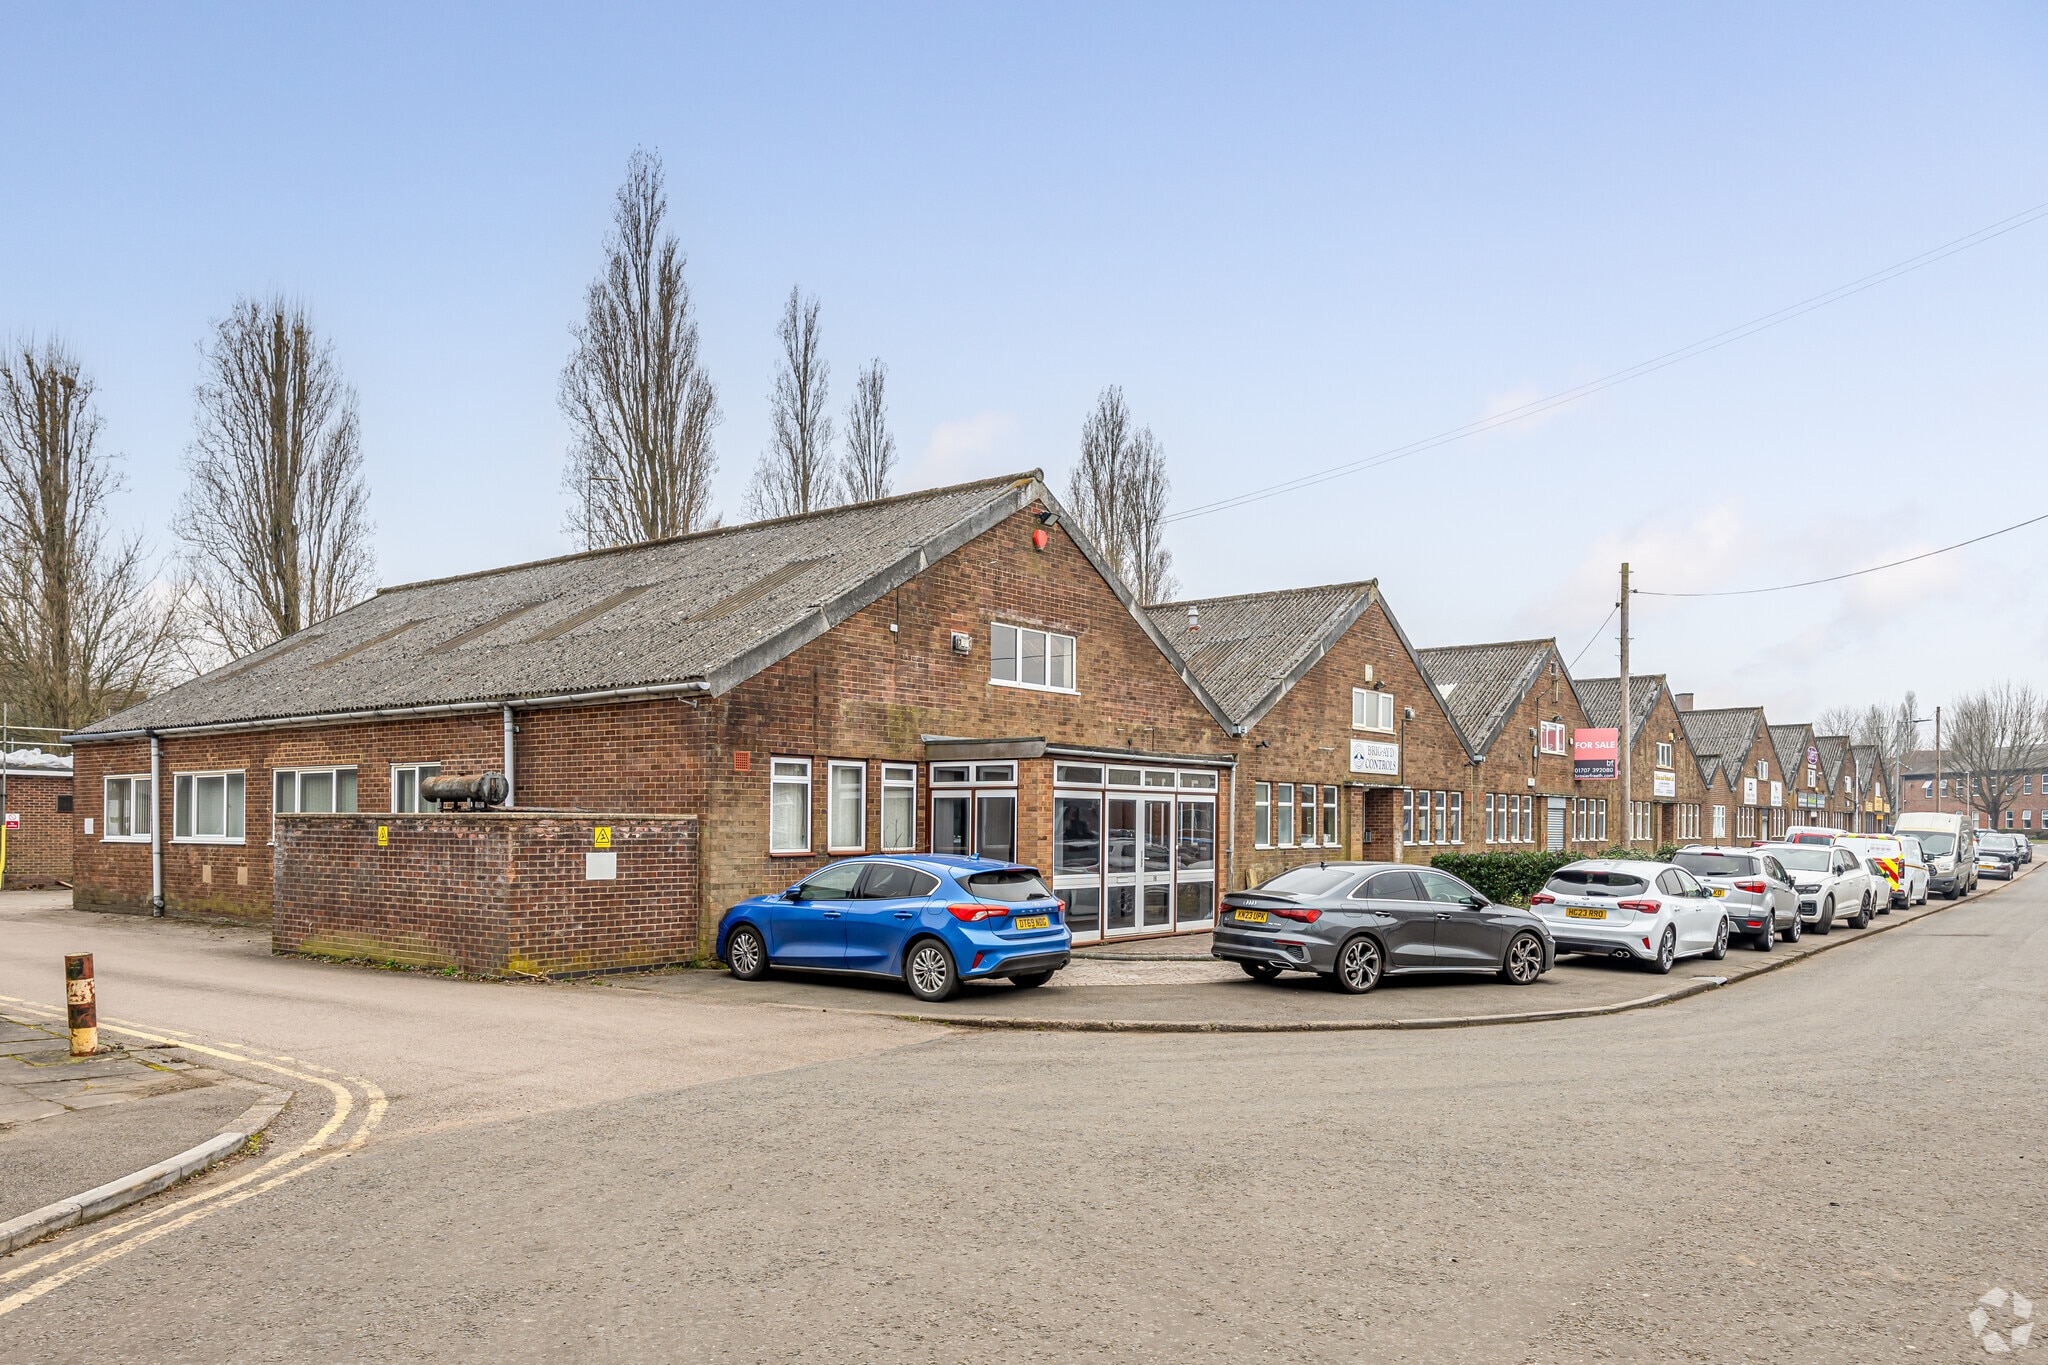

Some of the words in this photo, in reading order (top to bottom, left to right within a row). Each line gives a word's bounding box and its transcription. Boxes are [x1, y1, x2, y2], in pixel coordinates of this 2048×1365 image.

[1575, 741, 1592, 749] FOR
[1595, 741, 1615, 749] SALE
[1365, 759, 1396, 770] CONTROLS
